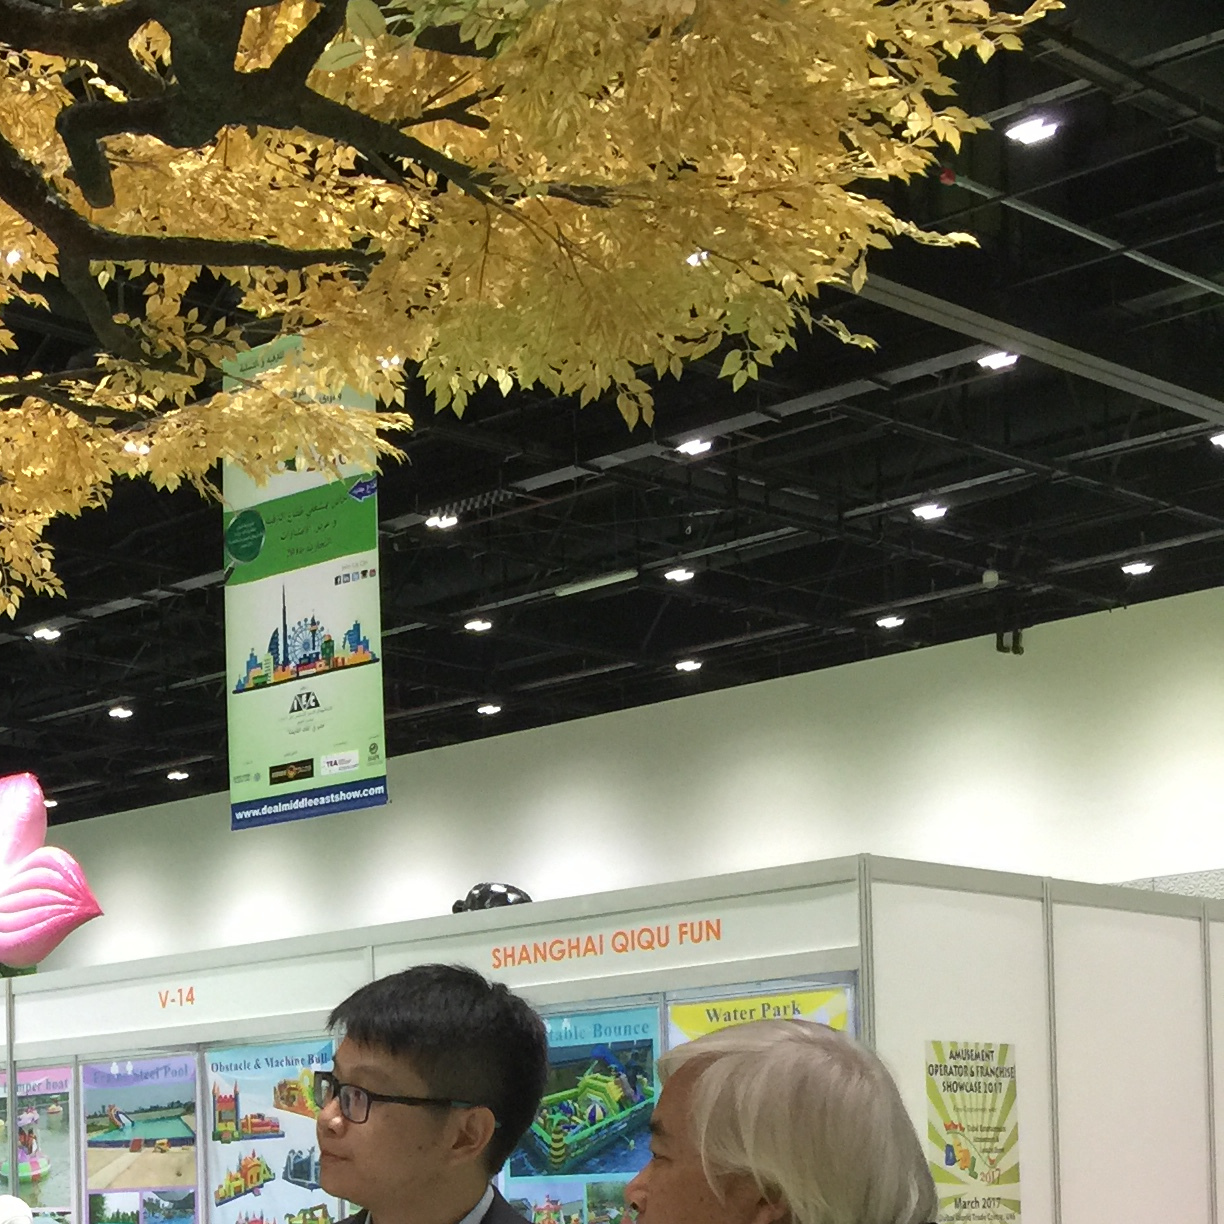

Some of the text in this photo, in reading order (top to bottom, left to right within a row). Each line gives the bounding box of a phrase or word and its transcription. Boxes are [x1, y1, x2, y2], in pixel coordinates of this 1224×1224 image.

[326, 760, 338, 768] TEA
[235, 785, 384, 819] www.dealmiddleeastshow.com
[491, 918, 721, 969] SHANGHAI QIQU FUN
[158, 987, 194, 1008] V-14
[706, 1001, 801, 1023] Water Park
[593, 1022, 649, 1038] Bounce
[949, 1049, 994, 1062] AMUSEMENT
[163, 1063, 189, 1078] Pool
[211, 1058, 251, 1074] Obstacle
[254, 1058, 262, 1070] &
[266, 1054, 306, 1069] Machine
[928, 1064, 968, 1077] OPERATOR
[976, 1065, 1016, 1079] FRANCHISE
[942, 1080, 1002, 1094] SHOWCASE 2017
[980, 1168, 1001, 1184] 2017
[954, 1197, 1001, 1210] March 2017
